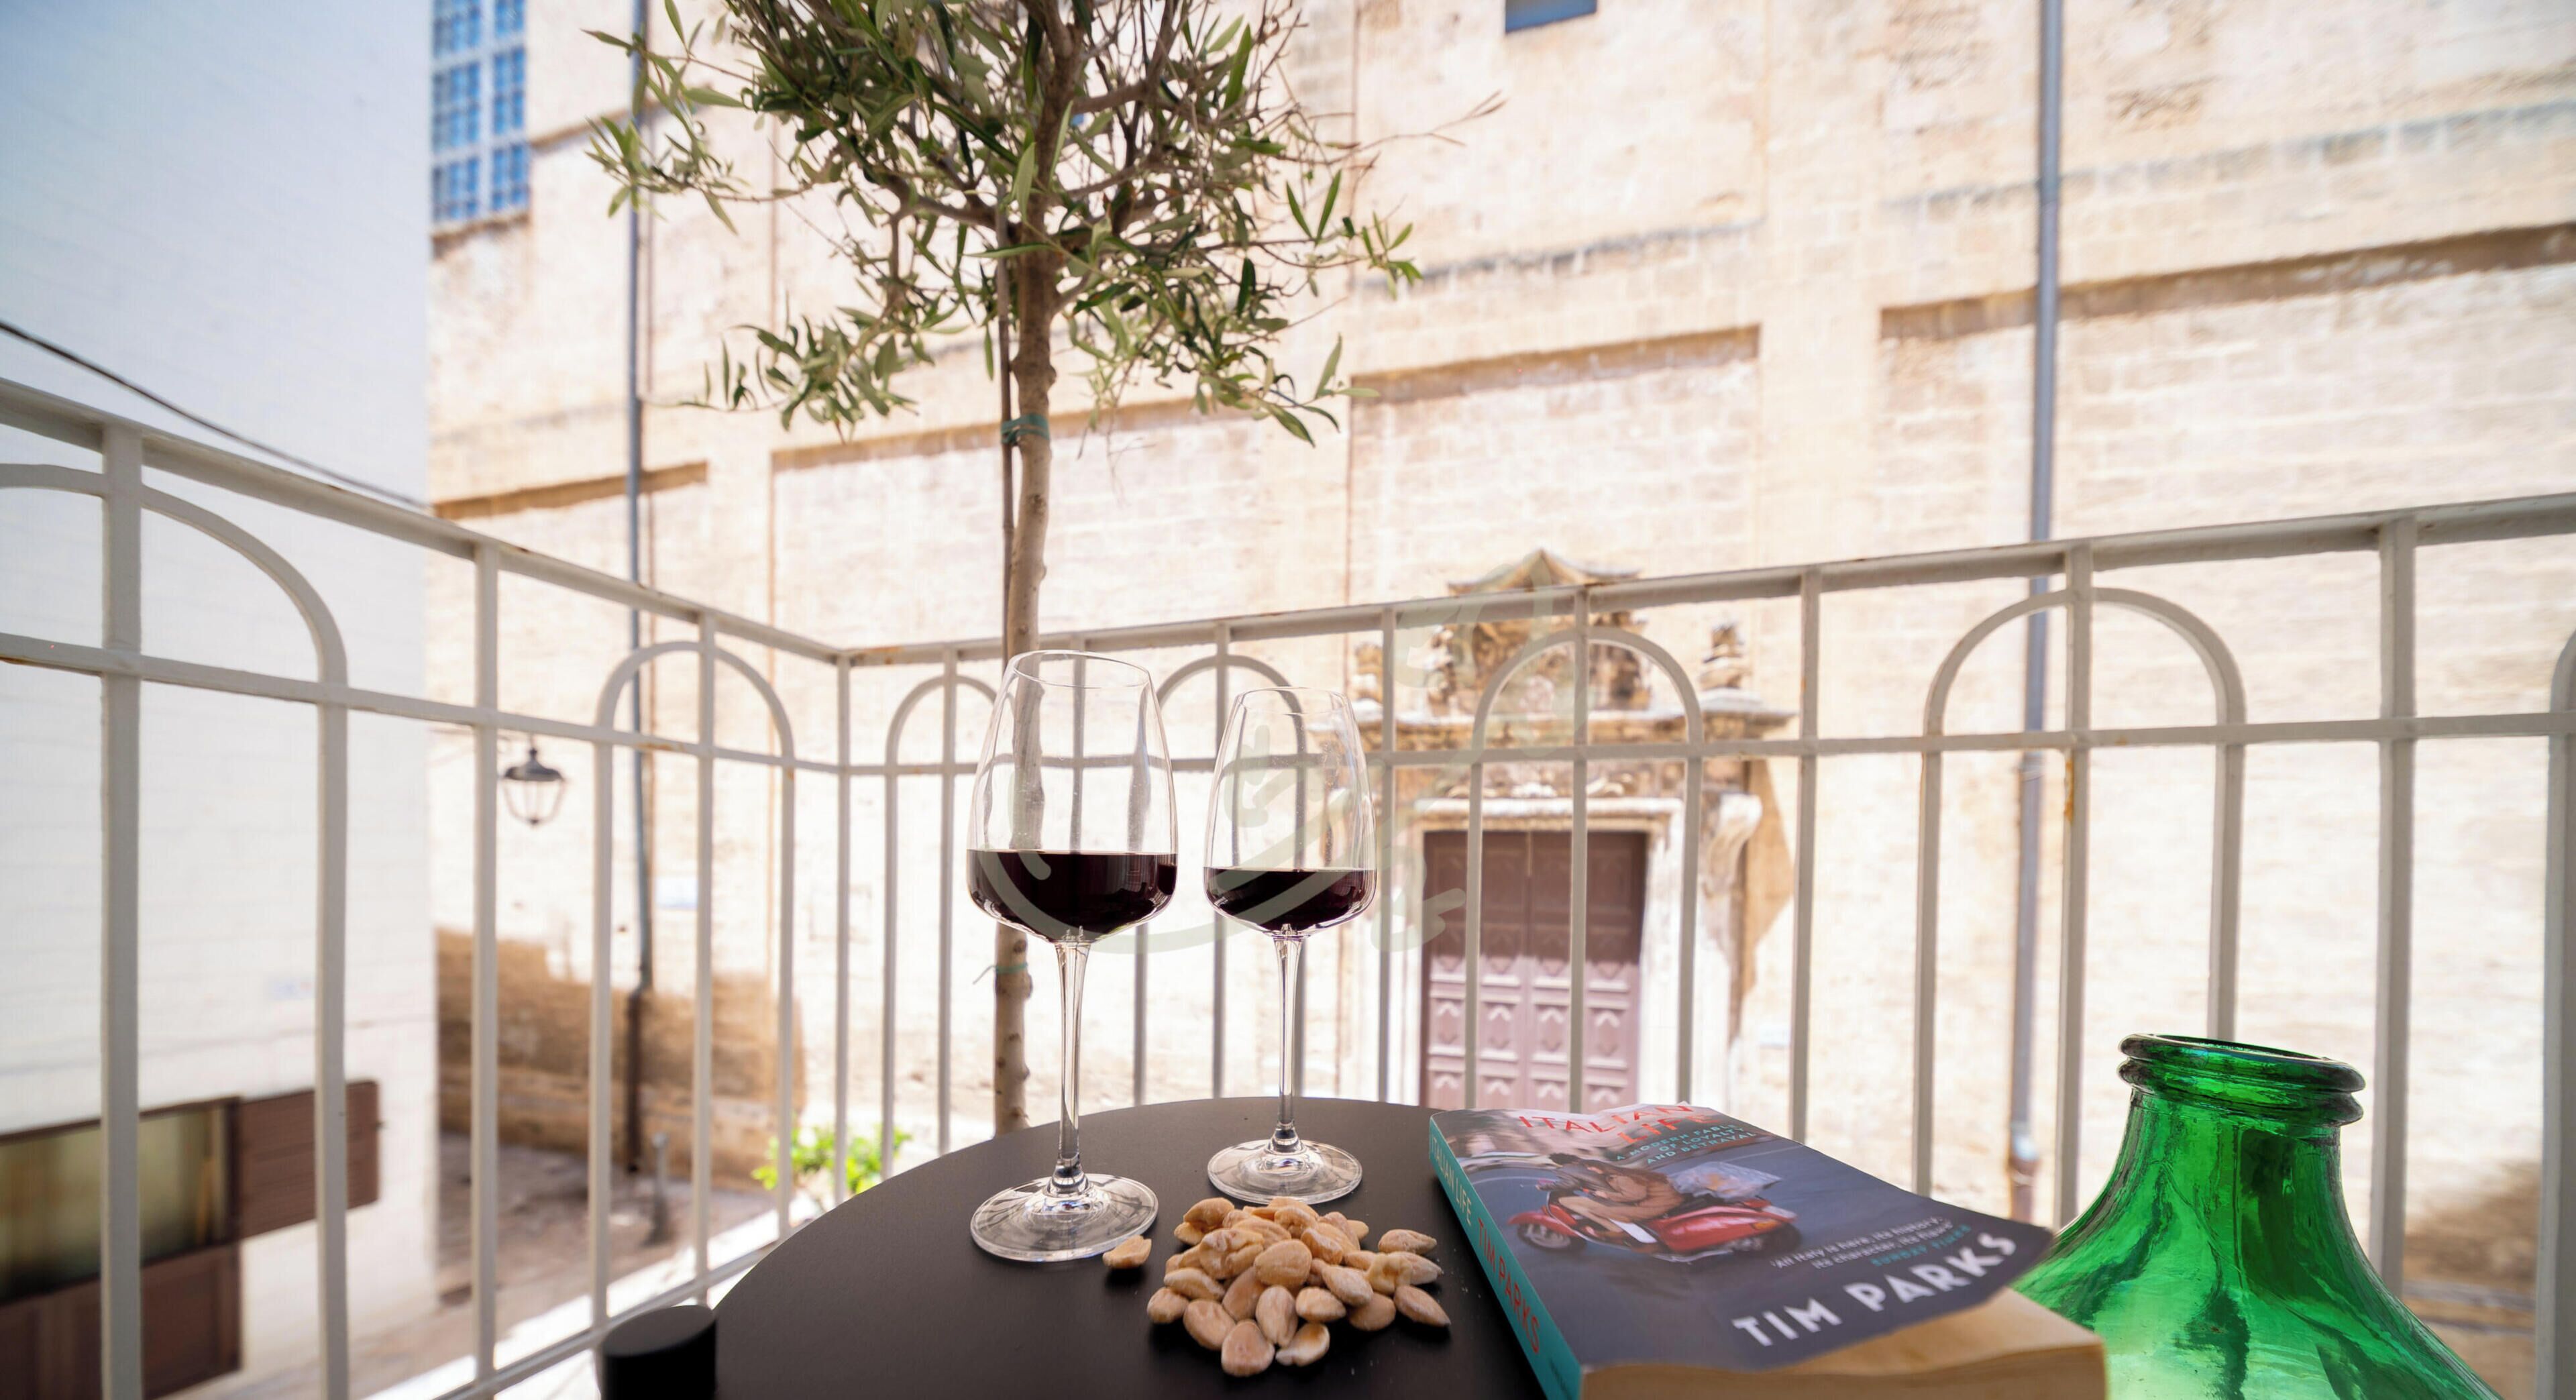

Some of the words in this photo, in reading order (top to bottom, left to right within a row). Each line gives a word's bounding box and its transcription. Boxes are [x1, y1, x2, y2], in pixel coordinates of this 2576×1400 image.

[1519, 1105, 1695, 1132] ITALIAN
[1617, 1114, 1722, 1144] LIFE
[1629, 1134, 1690, 1156] MODERN
[1647, 1151, 1676, 1165] AND
[1681, 1132, 1758, 1152] BETRAYAL
[1659, 1143, 1677, 1152] OF
[1682, 1127, 1744, 1144] LOYALTY
[1432, 1134, 1454, 1194] ITALIAN
[1456, 1177, 1471, 1226] LIFE
[1792, 1248, 1825, 1262] Italy
[1478, 1218, 1495, 1273] TIM
[1499, 1255, 1540, 1354] PARKS
[1731, 1297, 1843, 1347] TIM
[1843, 1232, 2017, 1313] PARKS
